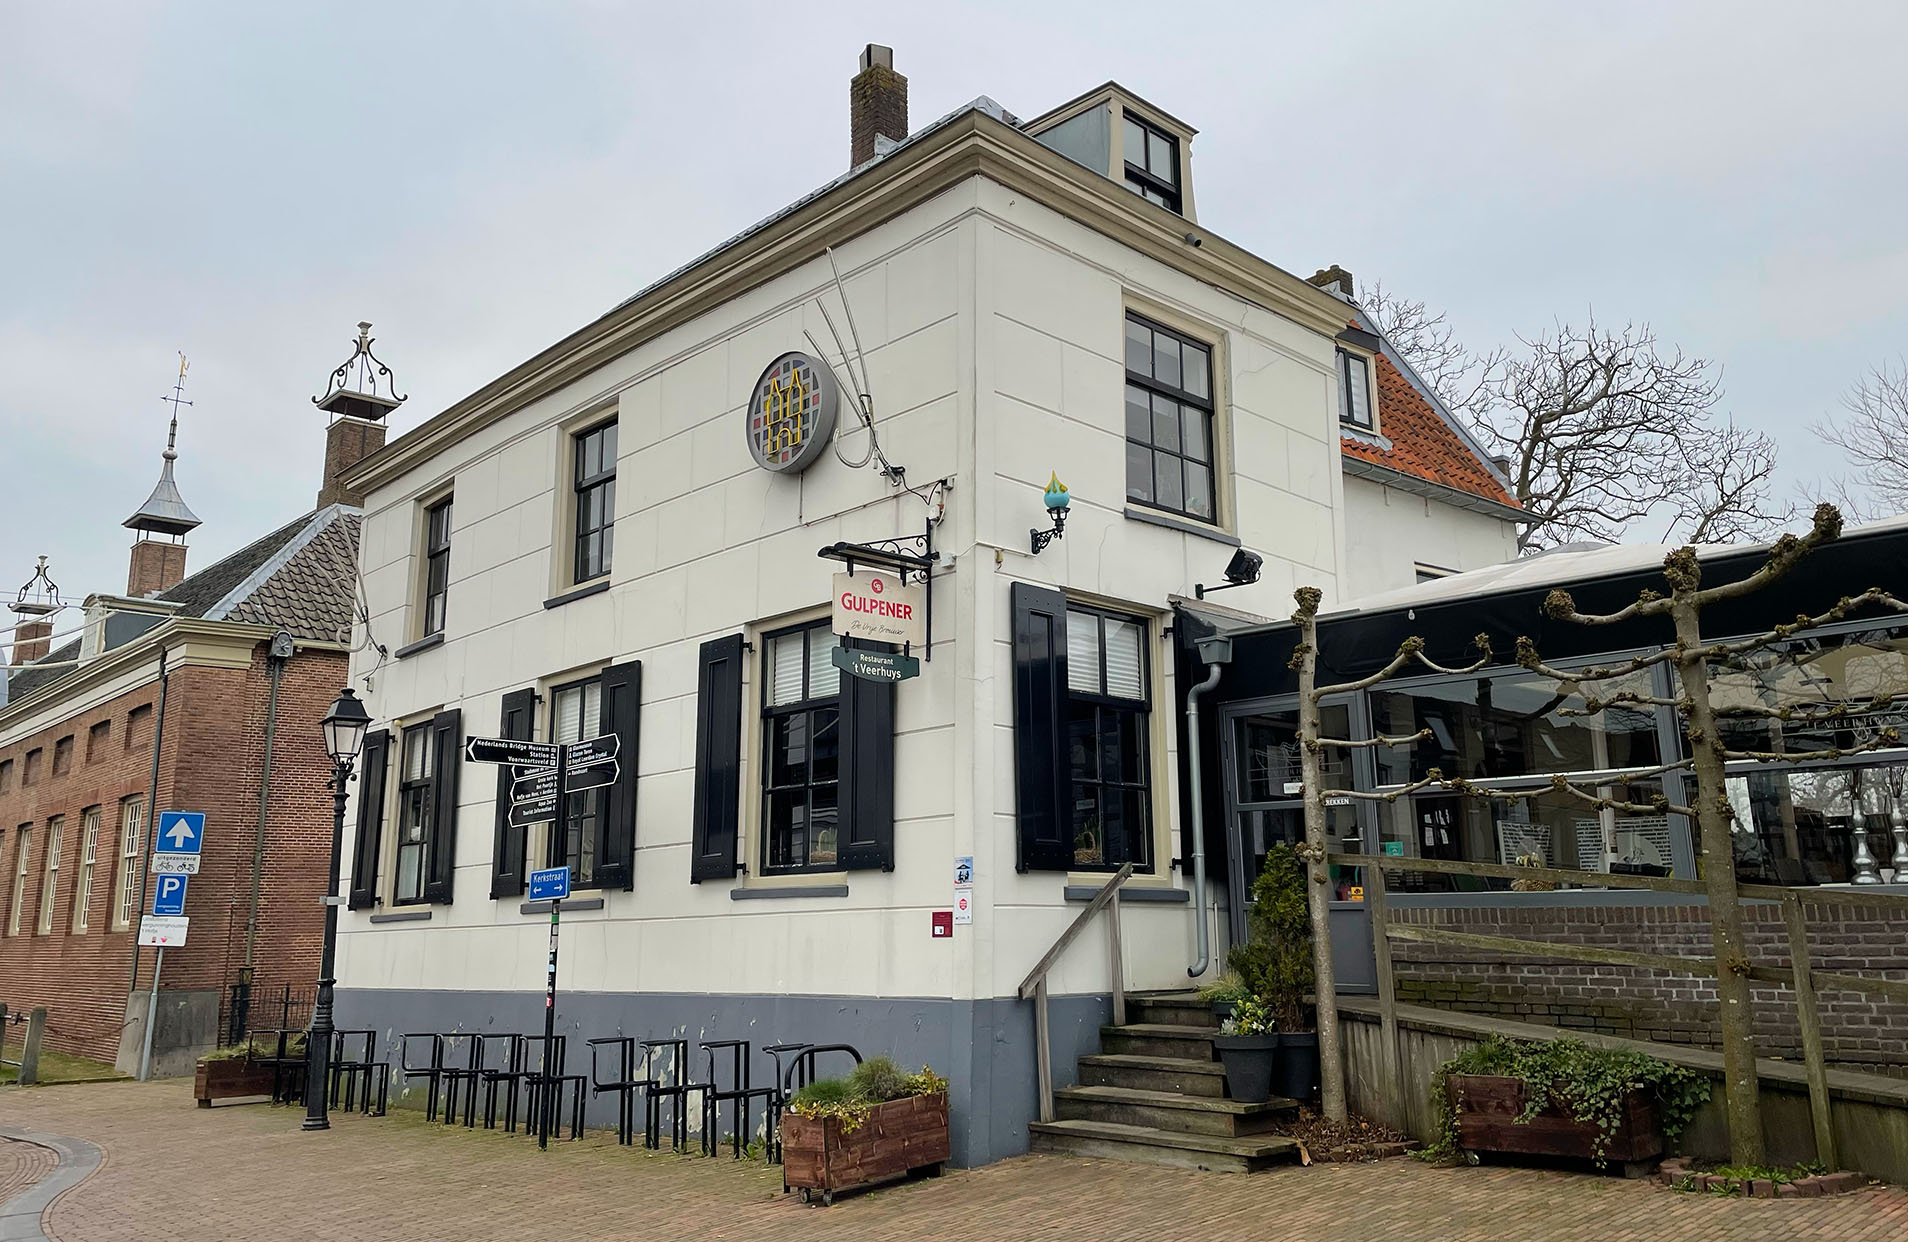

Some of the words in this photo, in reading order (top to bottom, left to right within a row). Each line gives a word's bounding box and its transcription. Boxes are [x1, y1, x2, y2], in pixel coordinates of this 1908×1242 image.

[841, 592, 912, 620] GULPENER
[860, 654, 894, 666] Restaurant
[860, 664, 902, 680] Veerhuys
[476, 740, 508, 748] Nederlands
[534, 872, 564, 883] Kerkstraat
[162, 878, 180, 898] P
